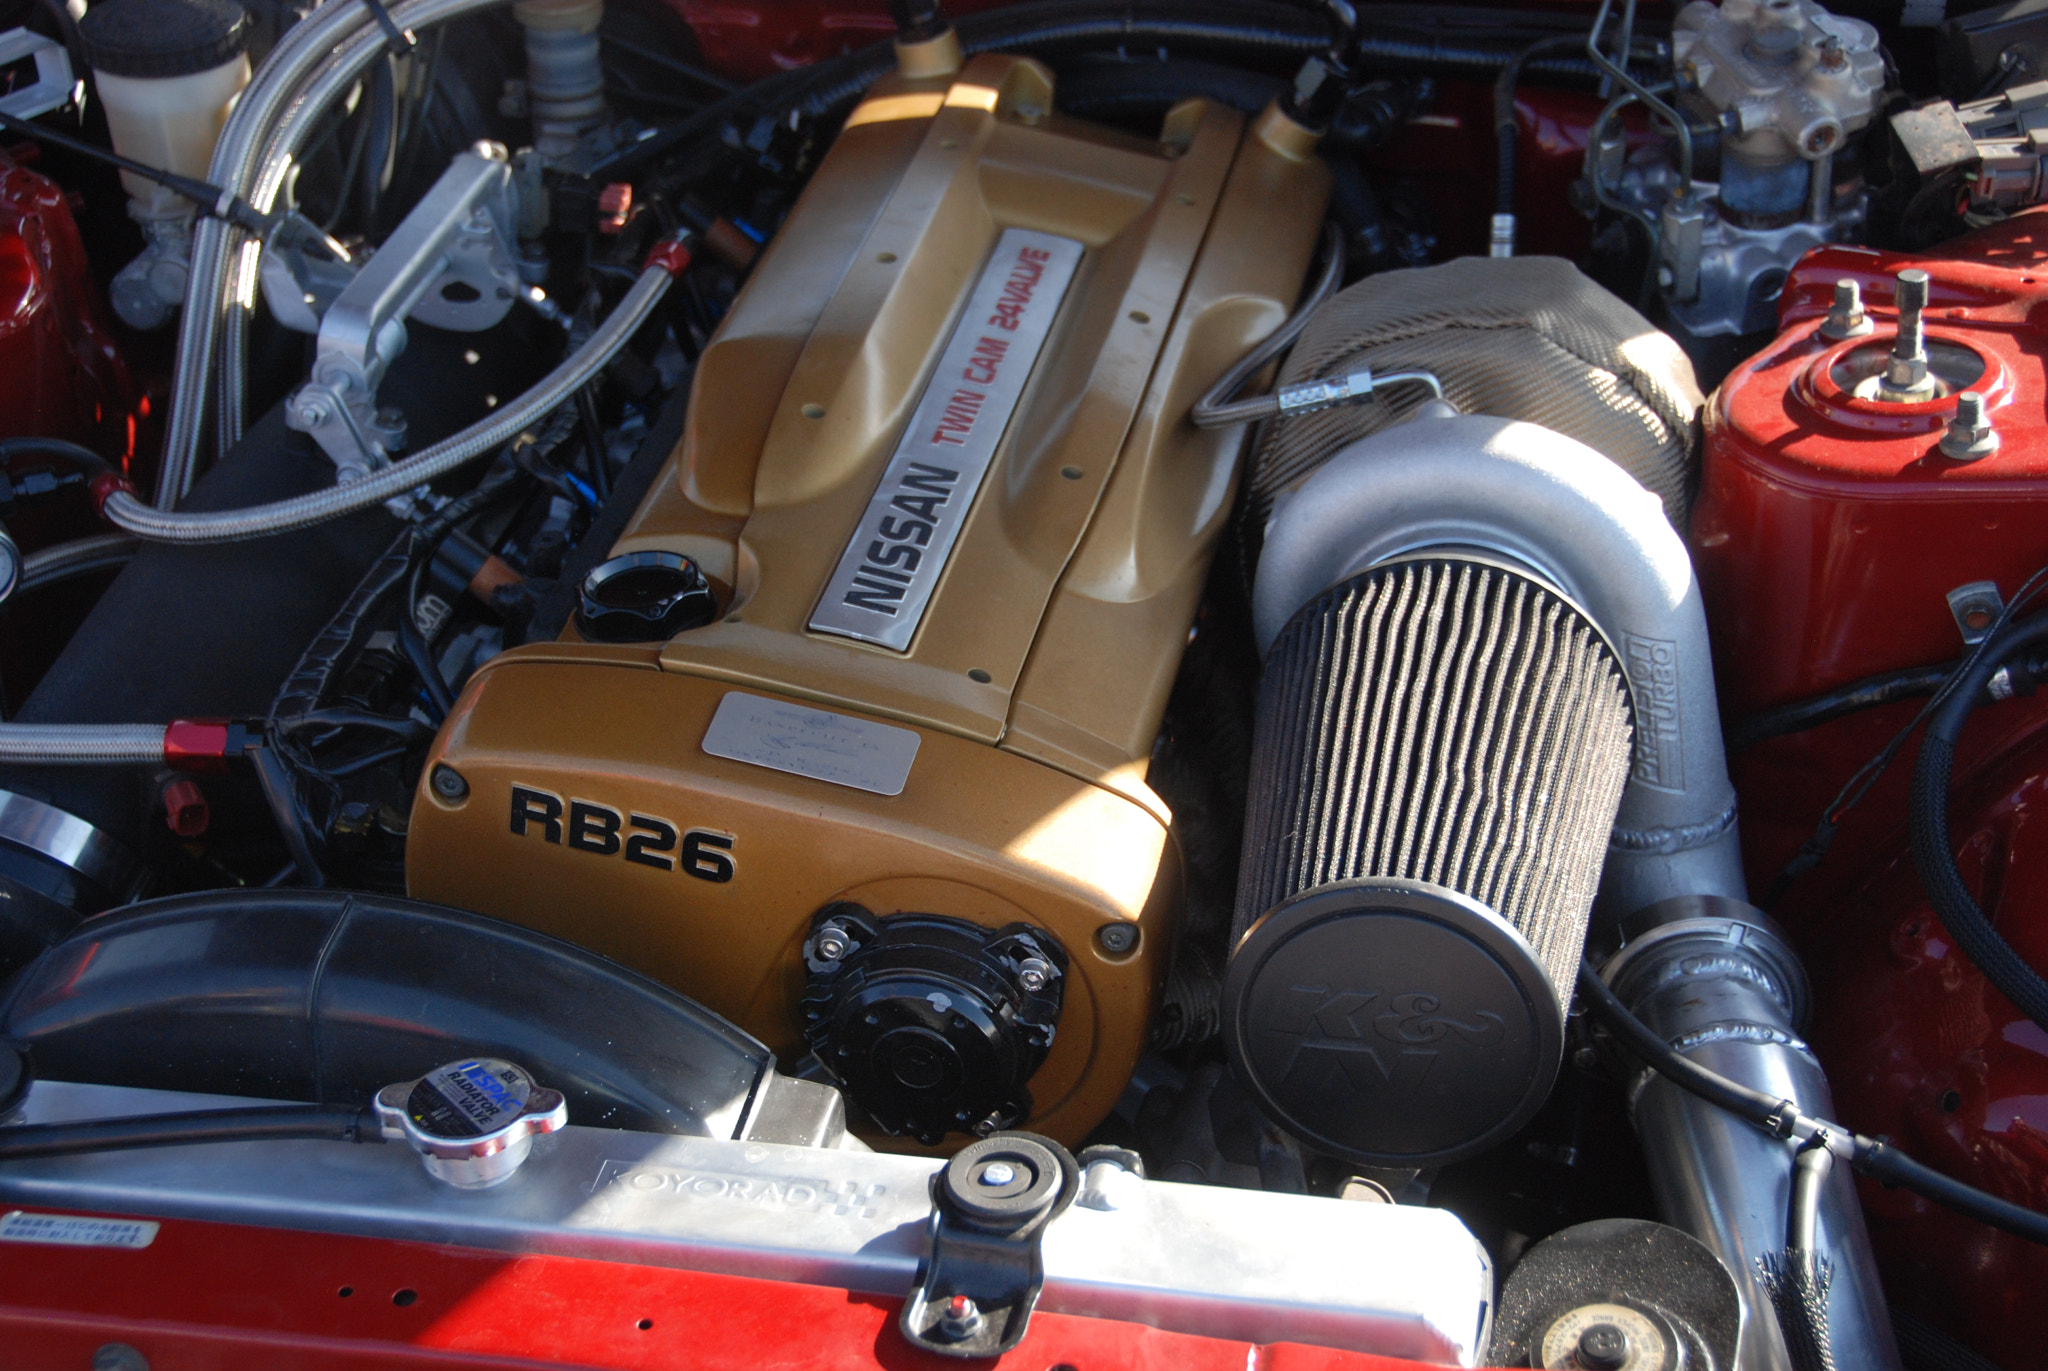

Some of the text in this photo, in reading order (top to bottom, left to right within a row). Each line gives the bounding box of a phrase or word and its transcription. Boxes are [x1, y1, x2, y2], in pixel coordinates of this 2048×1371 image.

[842, 247, 1051, 618] NISSAN TWIN CAM 24VALVE
[1650, 642, 1679, 737] TURBO
[510, 781, 738, 884] RB26
[447, 1071, 500, 1116] RADIATOR
[459, 1097, 493, 1125] VALVE
[606, 1166, 817, 1206] KOYORAD
